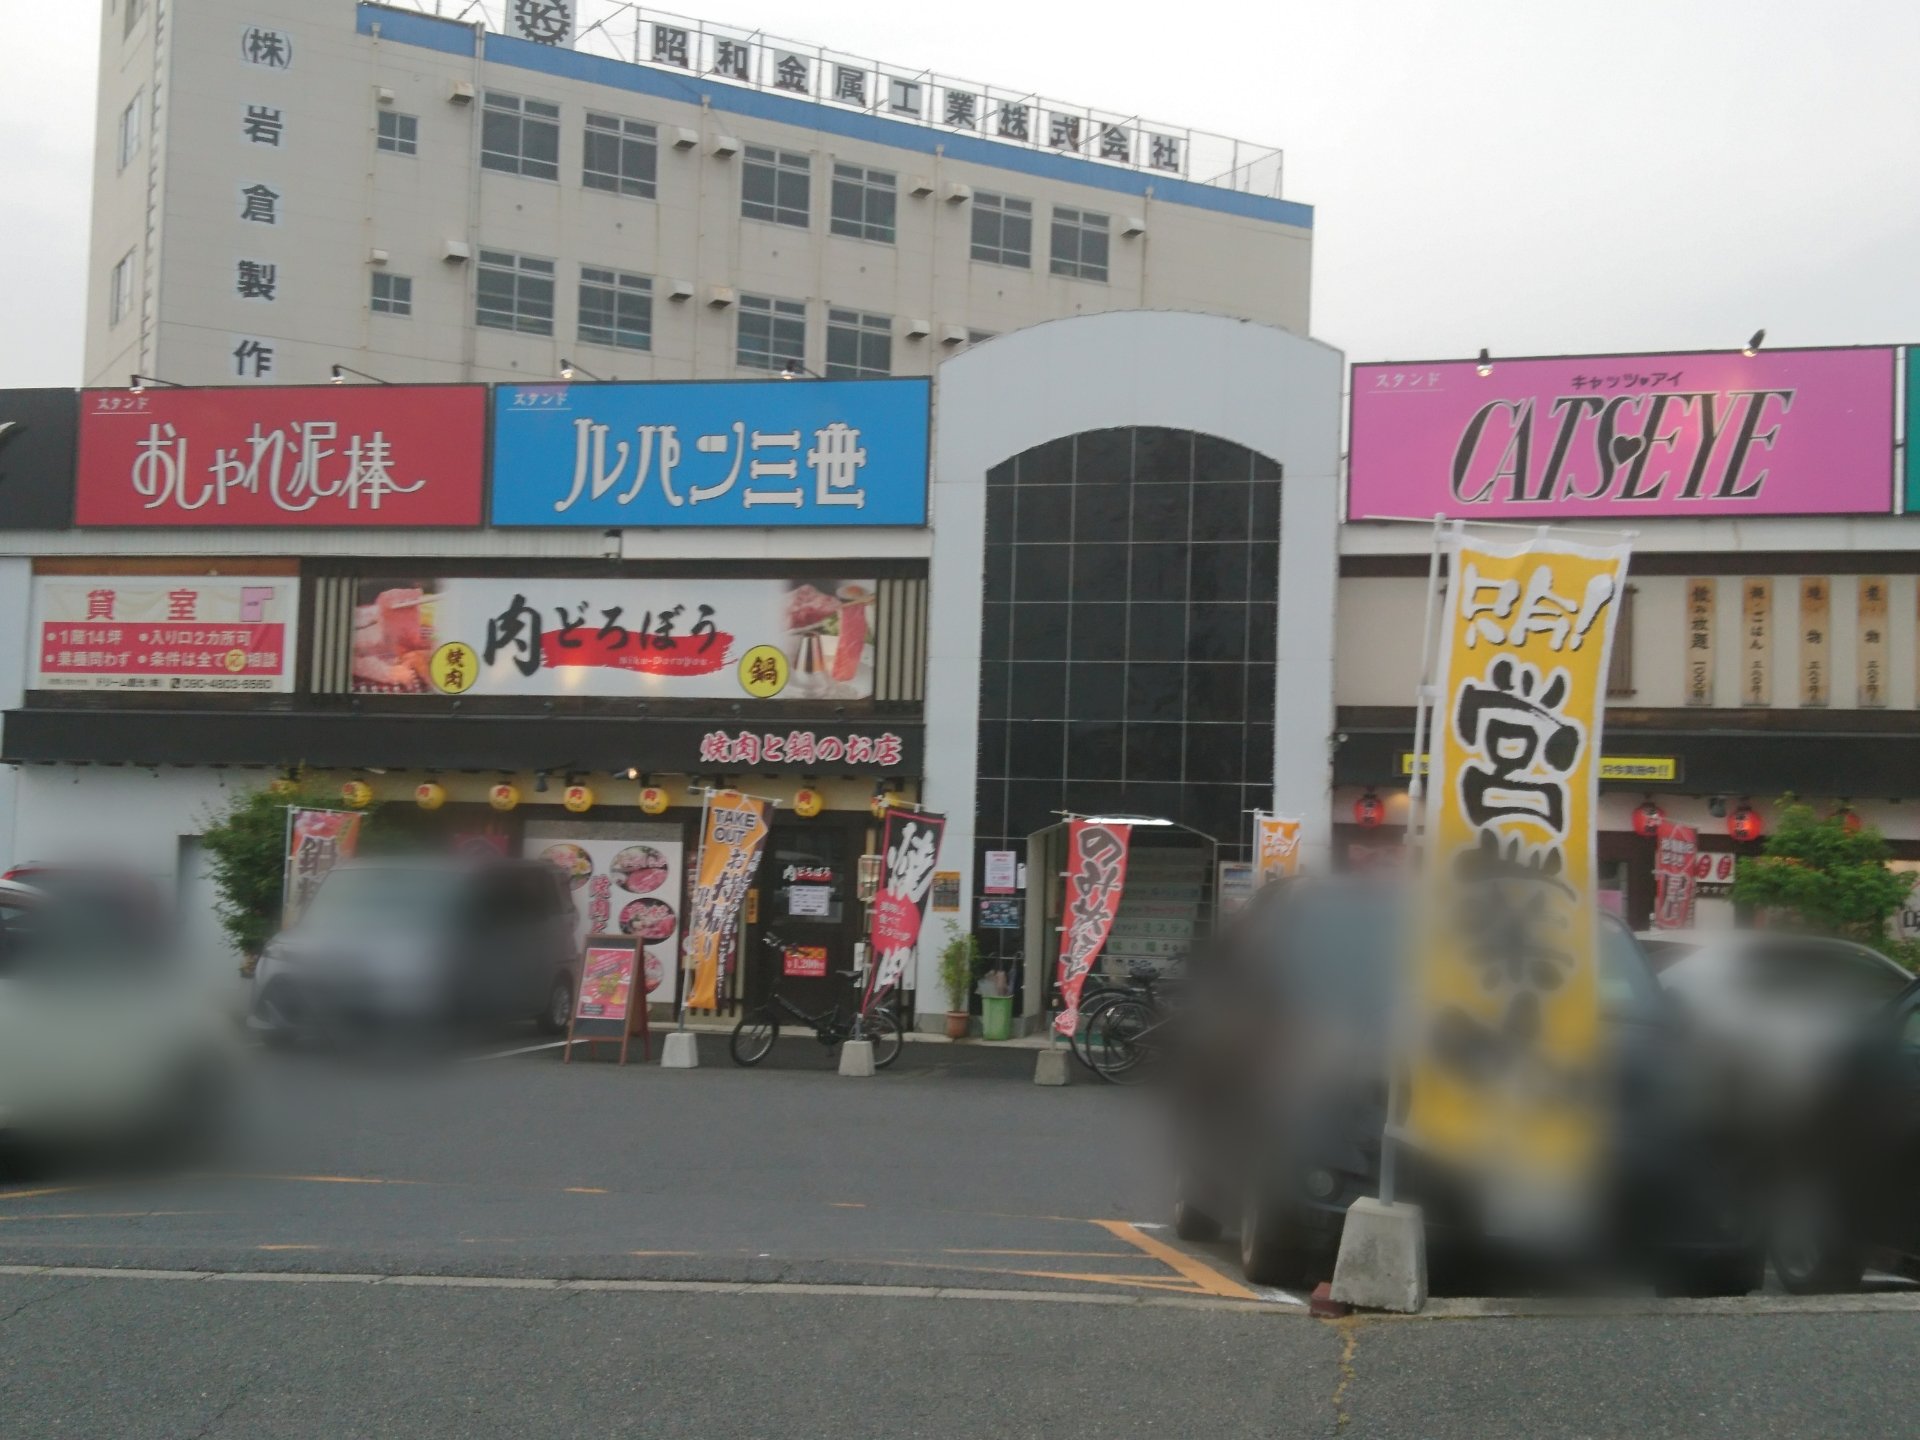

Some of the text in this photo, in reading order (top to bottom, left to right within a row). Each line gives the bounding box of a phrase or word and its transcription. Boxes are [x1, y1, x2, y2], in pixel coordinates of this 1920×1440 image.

[653, 23, 1181, 174] 昭和金属工業株式会社
[1374, 372, 1442, 389] スタンド
[97, 396, 151, 412] スタンド
[512, 391, 569, 407] スタンド
[131, 421, 427, 512] おしゃれ泥棒
[554, 417, 868, 513] ルパン三世
[482, 592, 723, 678] 肉どろぼう
[442, 643, 467, 689] 焼肉
[747, 656, 779, 688] 鍋
[699, 730, 903, 766] 焼肉と鍋のお店
[713, 808, 757, 829] TAKE
[713, 827, 747, 844] OUT
